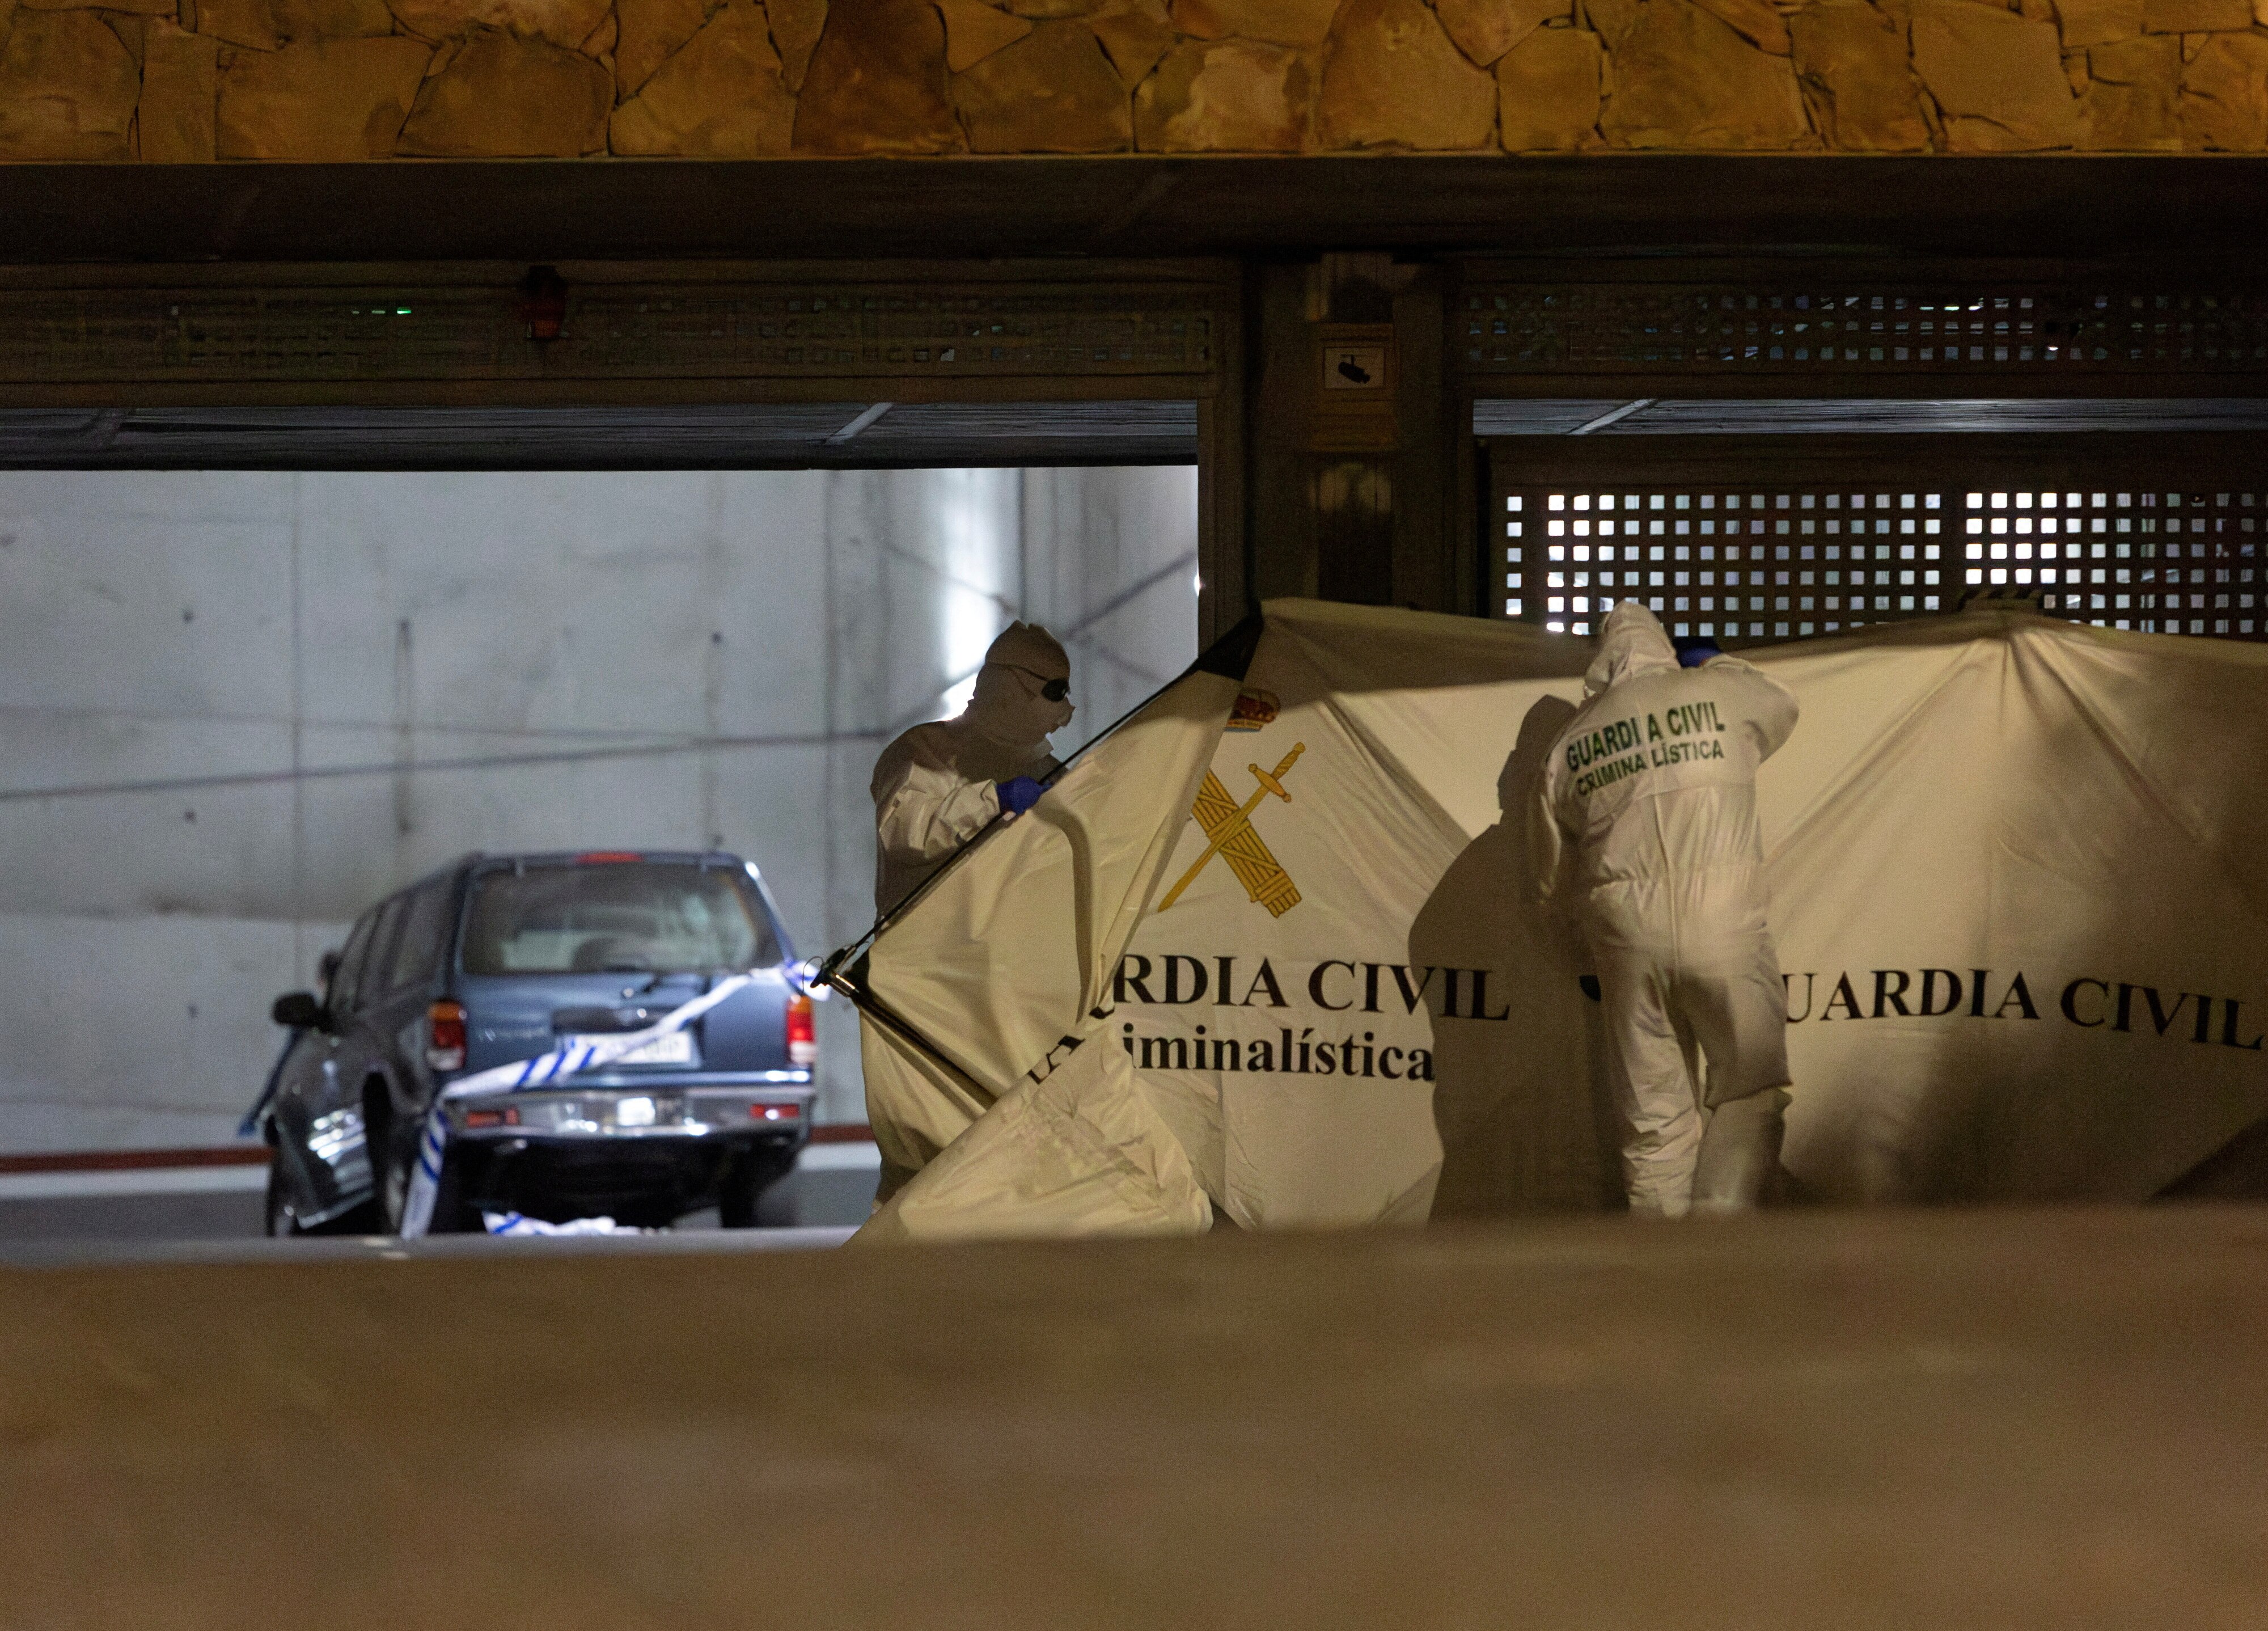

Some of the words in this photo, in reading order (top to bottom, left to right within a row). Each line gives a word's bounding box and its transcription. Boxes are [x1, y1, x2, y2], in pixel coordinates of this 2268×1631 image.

[1667, 702, 1725, 736] CIVIL
[1308, 960, 1510, 1021] CIVIL
[2060, 978, 2264, 1050] CIVIL
